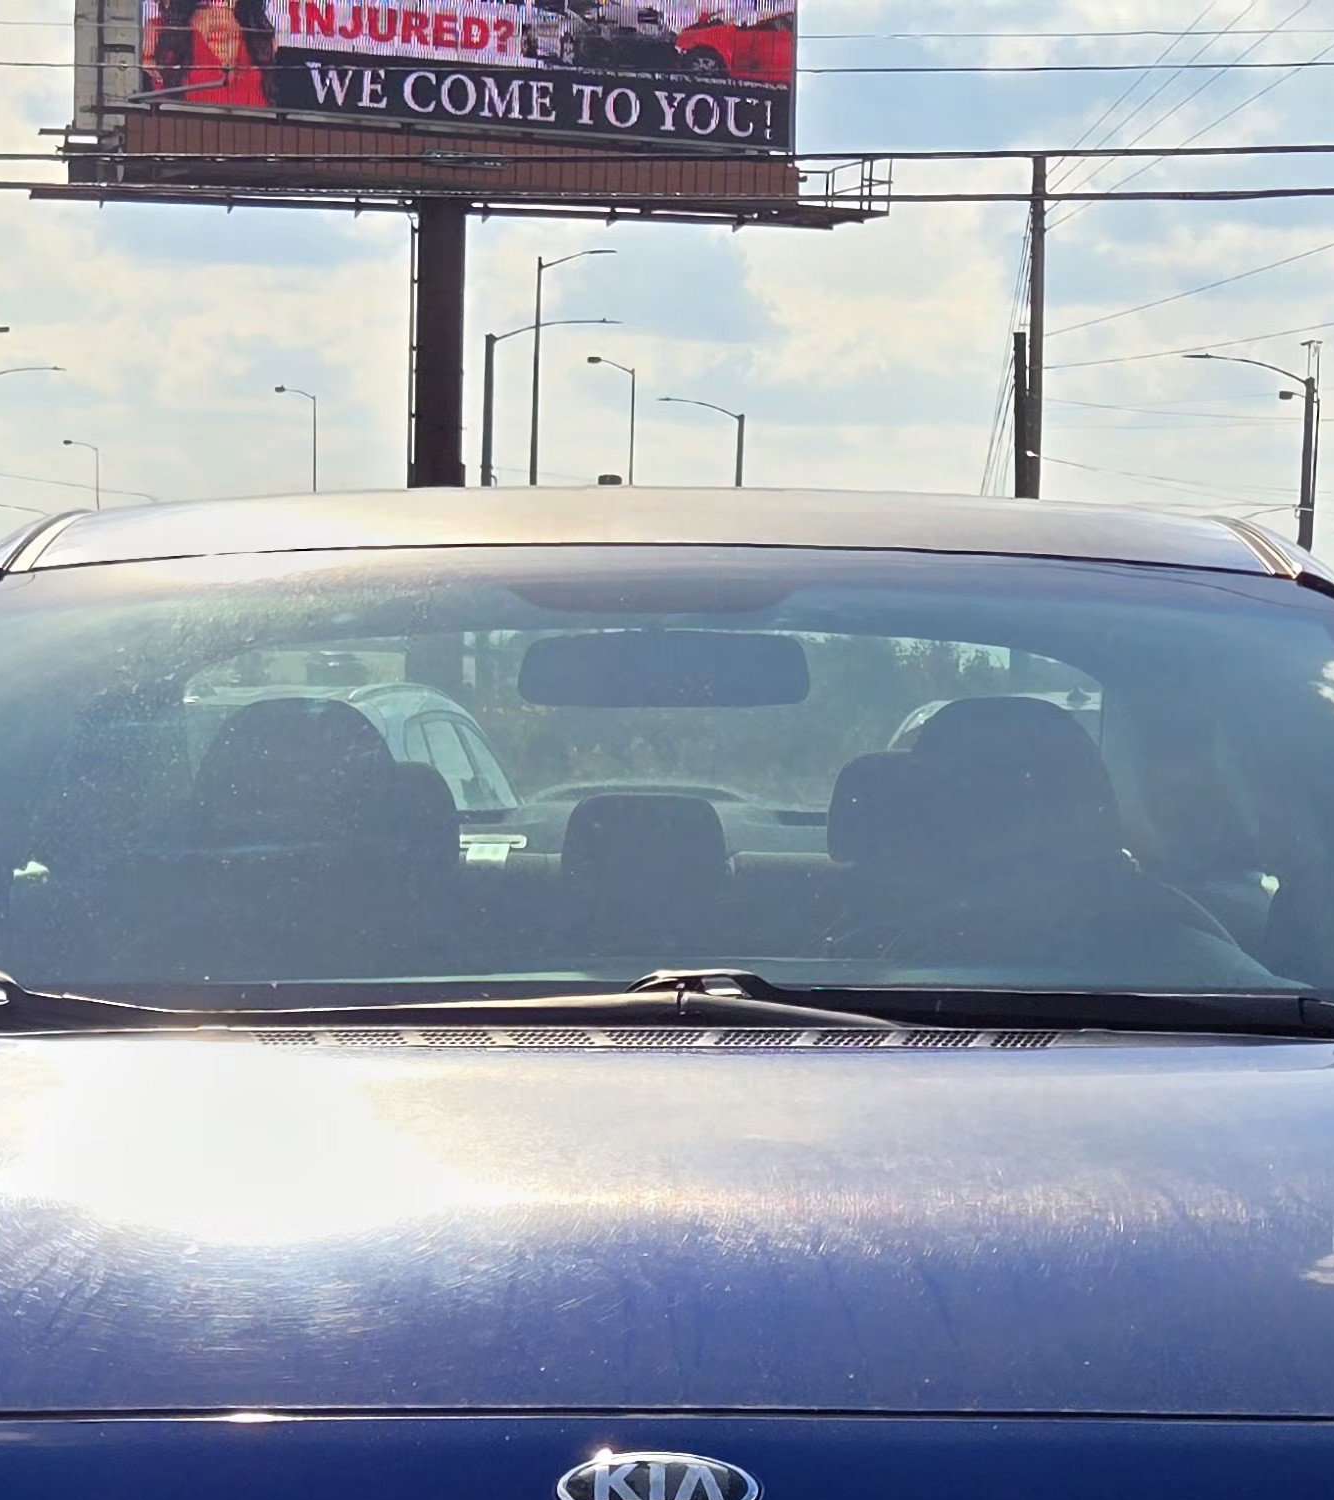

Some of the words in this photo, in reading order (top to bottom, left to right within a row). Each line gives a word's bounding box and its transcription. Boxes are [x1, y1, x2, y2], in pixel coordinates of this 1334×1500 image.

[288, 0, 515, 53] INJURED?
[305, 62, 387, 108] WE
[403, 71, 556, 122] COME
[572, 84, 641, 128] TO
[654, 90, 773, 140] YOU!
